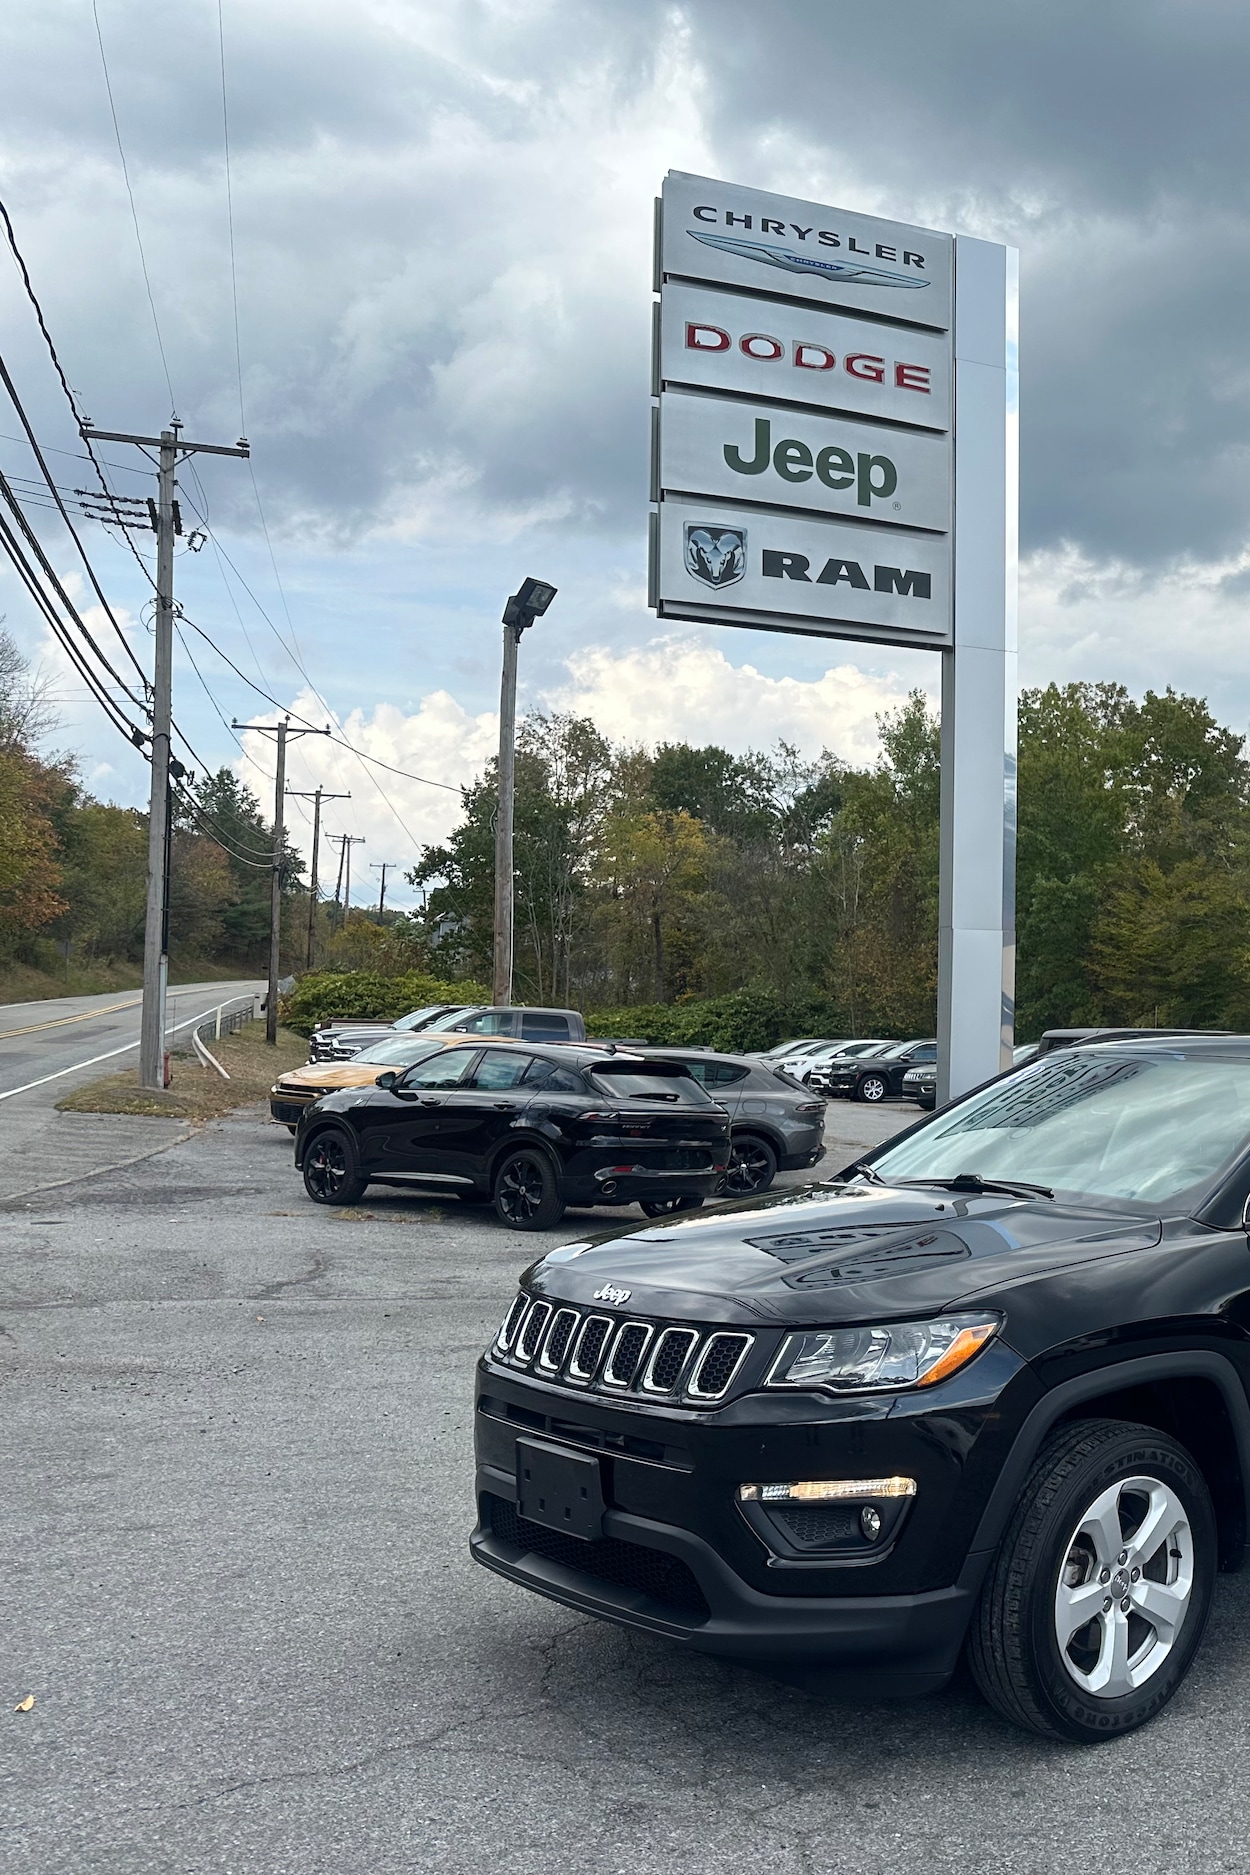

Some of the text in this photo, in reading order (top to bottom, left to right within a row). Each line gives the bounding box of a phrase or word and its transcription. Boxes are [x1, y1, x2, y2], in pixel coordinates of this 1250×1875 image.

[692, 205, 926, 270] CHRYSLER
[685, 321, 932, 395] DODGE
[723, 417, 898, 507] Jeep
[762, 549, 932, 600] RAM
[593, 1282, 632, 1306] Jeep
